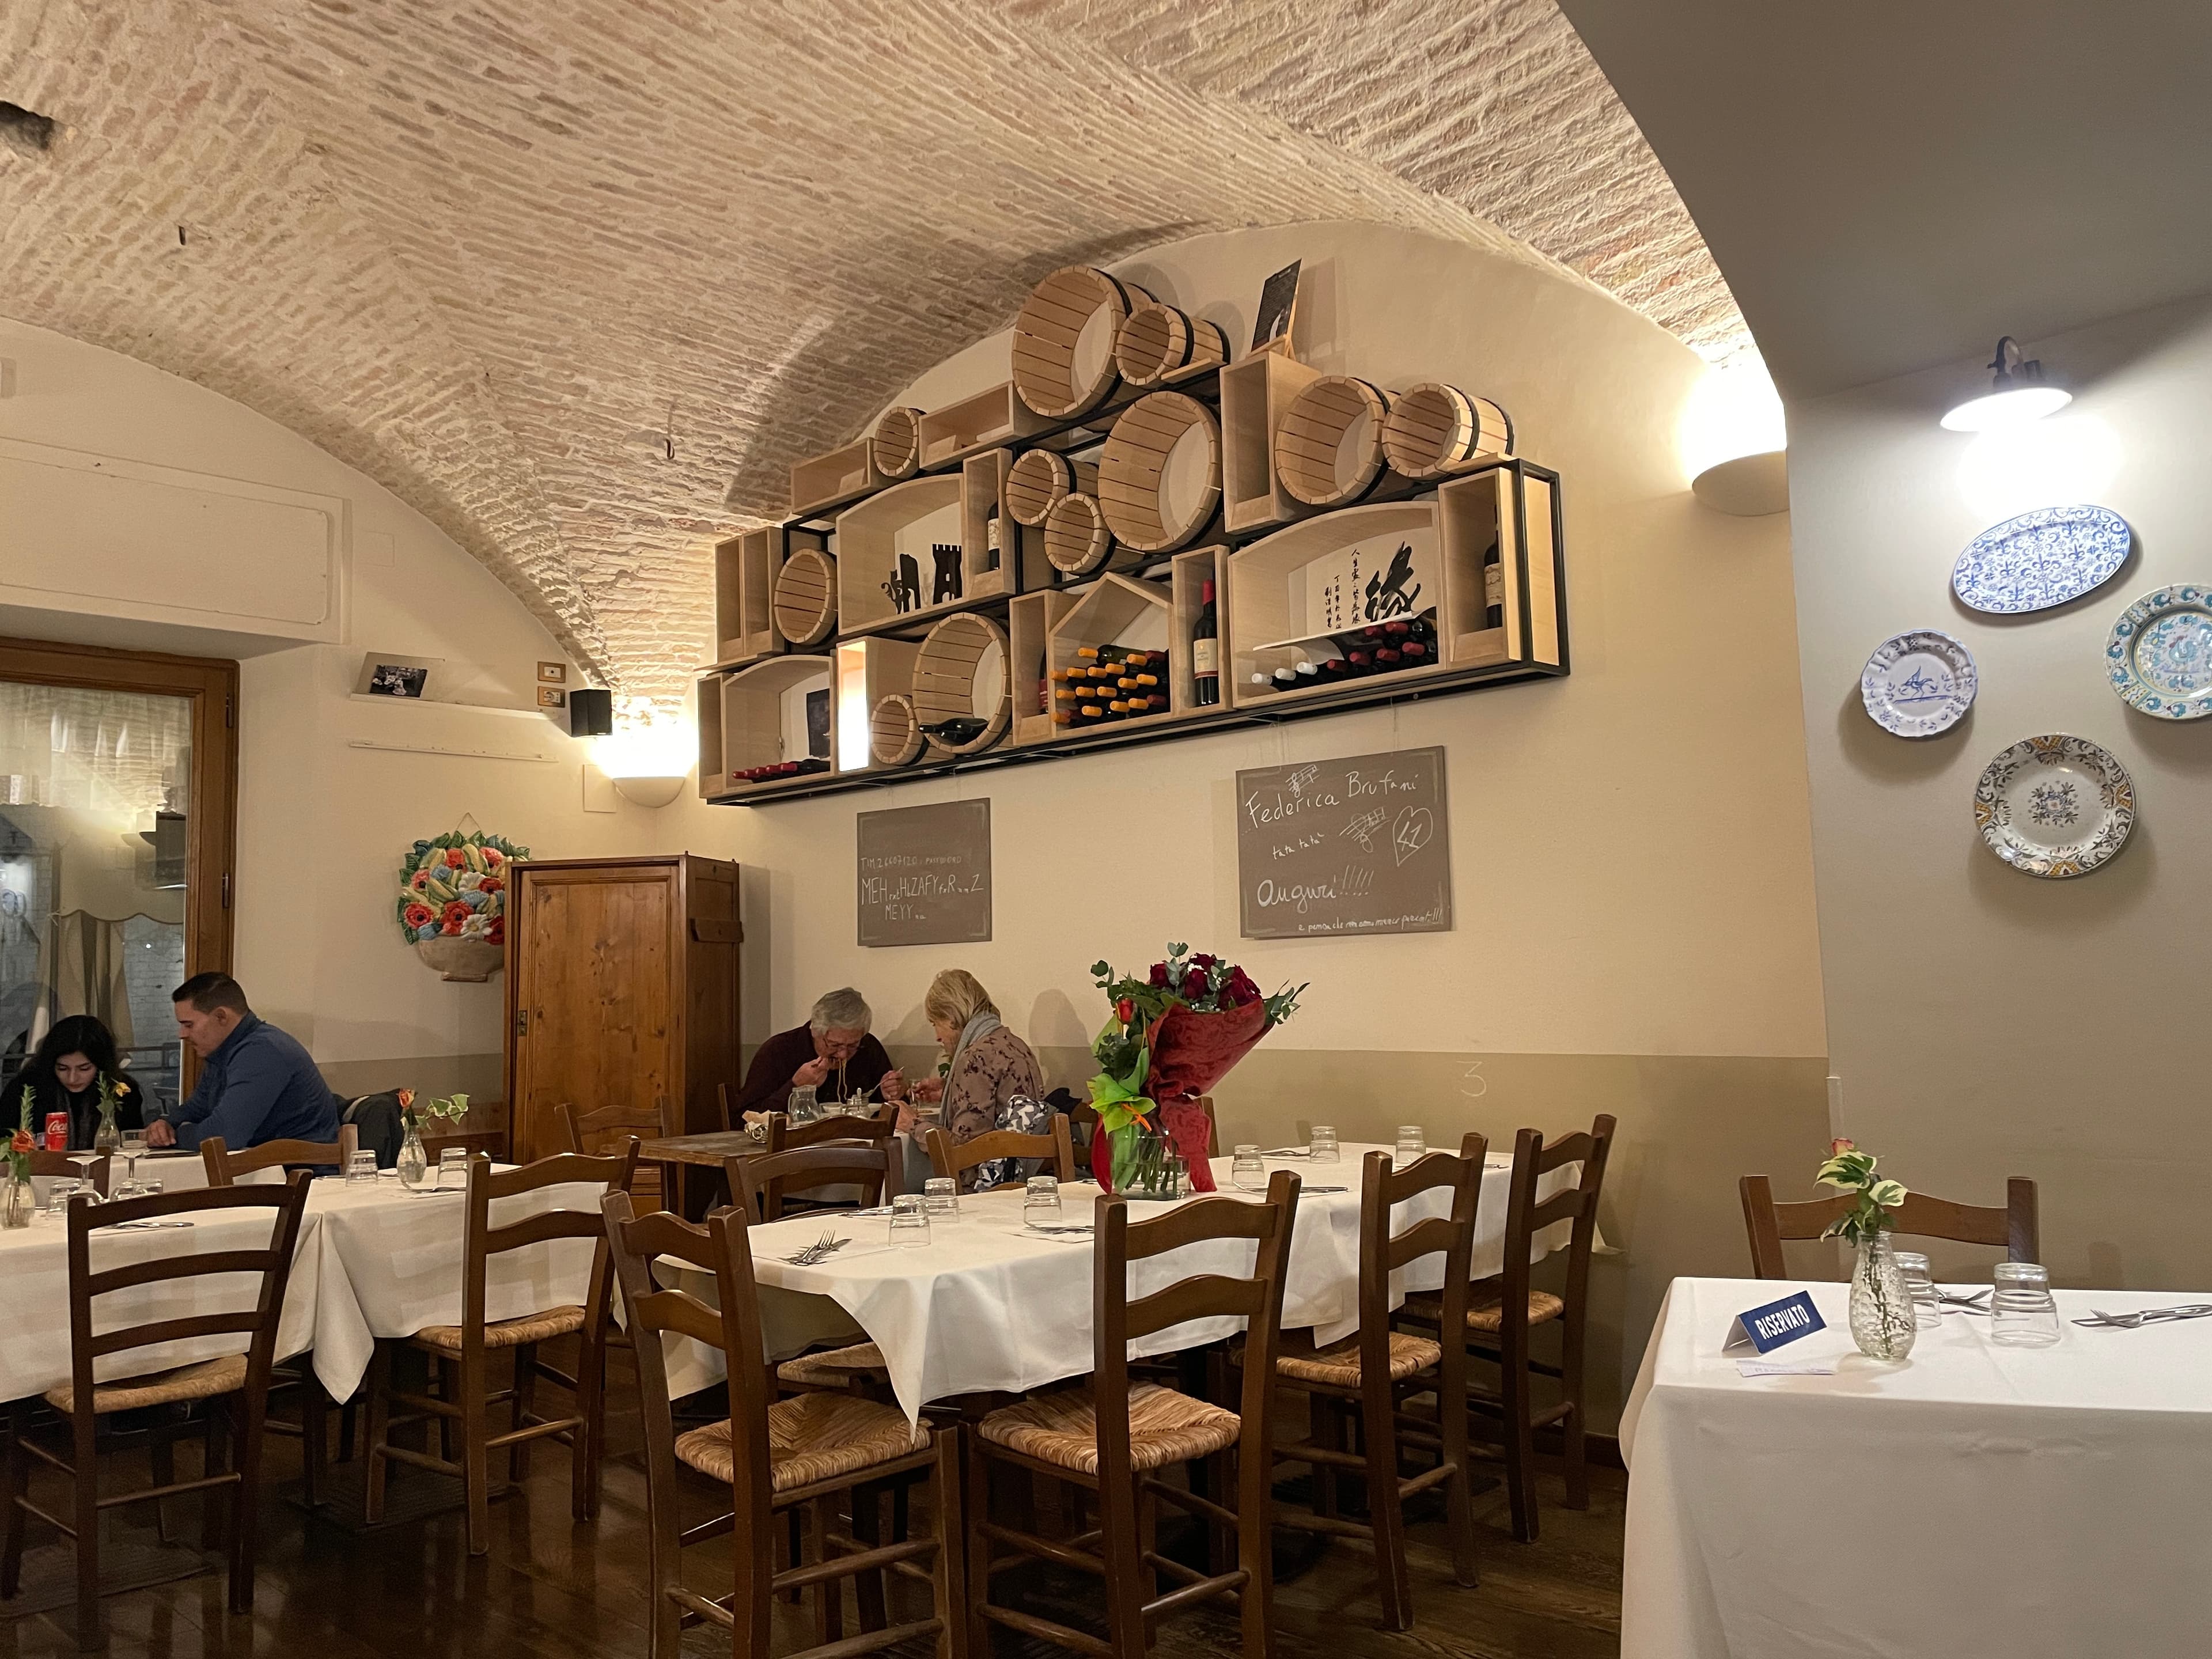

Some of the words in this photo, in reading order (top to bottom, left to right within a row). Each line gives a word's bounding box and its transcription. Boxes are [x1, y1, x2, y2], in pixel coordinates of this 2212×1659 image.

[1245, 791, 1340, 828] Federica
[1346, 770, 1419, 798] Brufani
[1456, 1060, 1486, 1097] 3
[1754, 1304, 1810, 1340] RISERVATO
